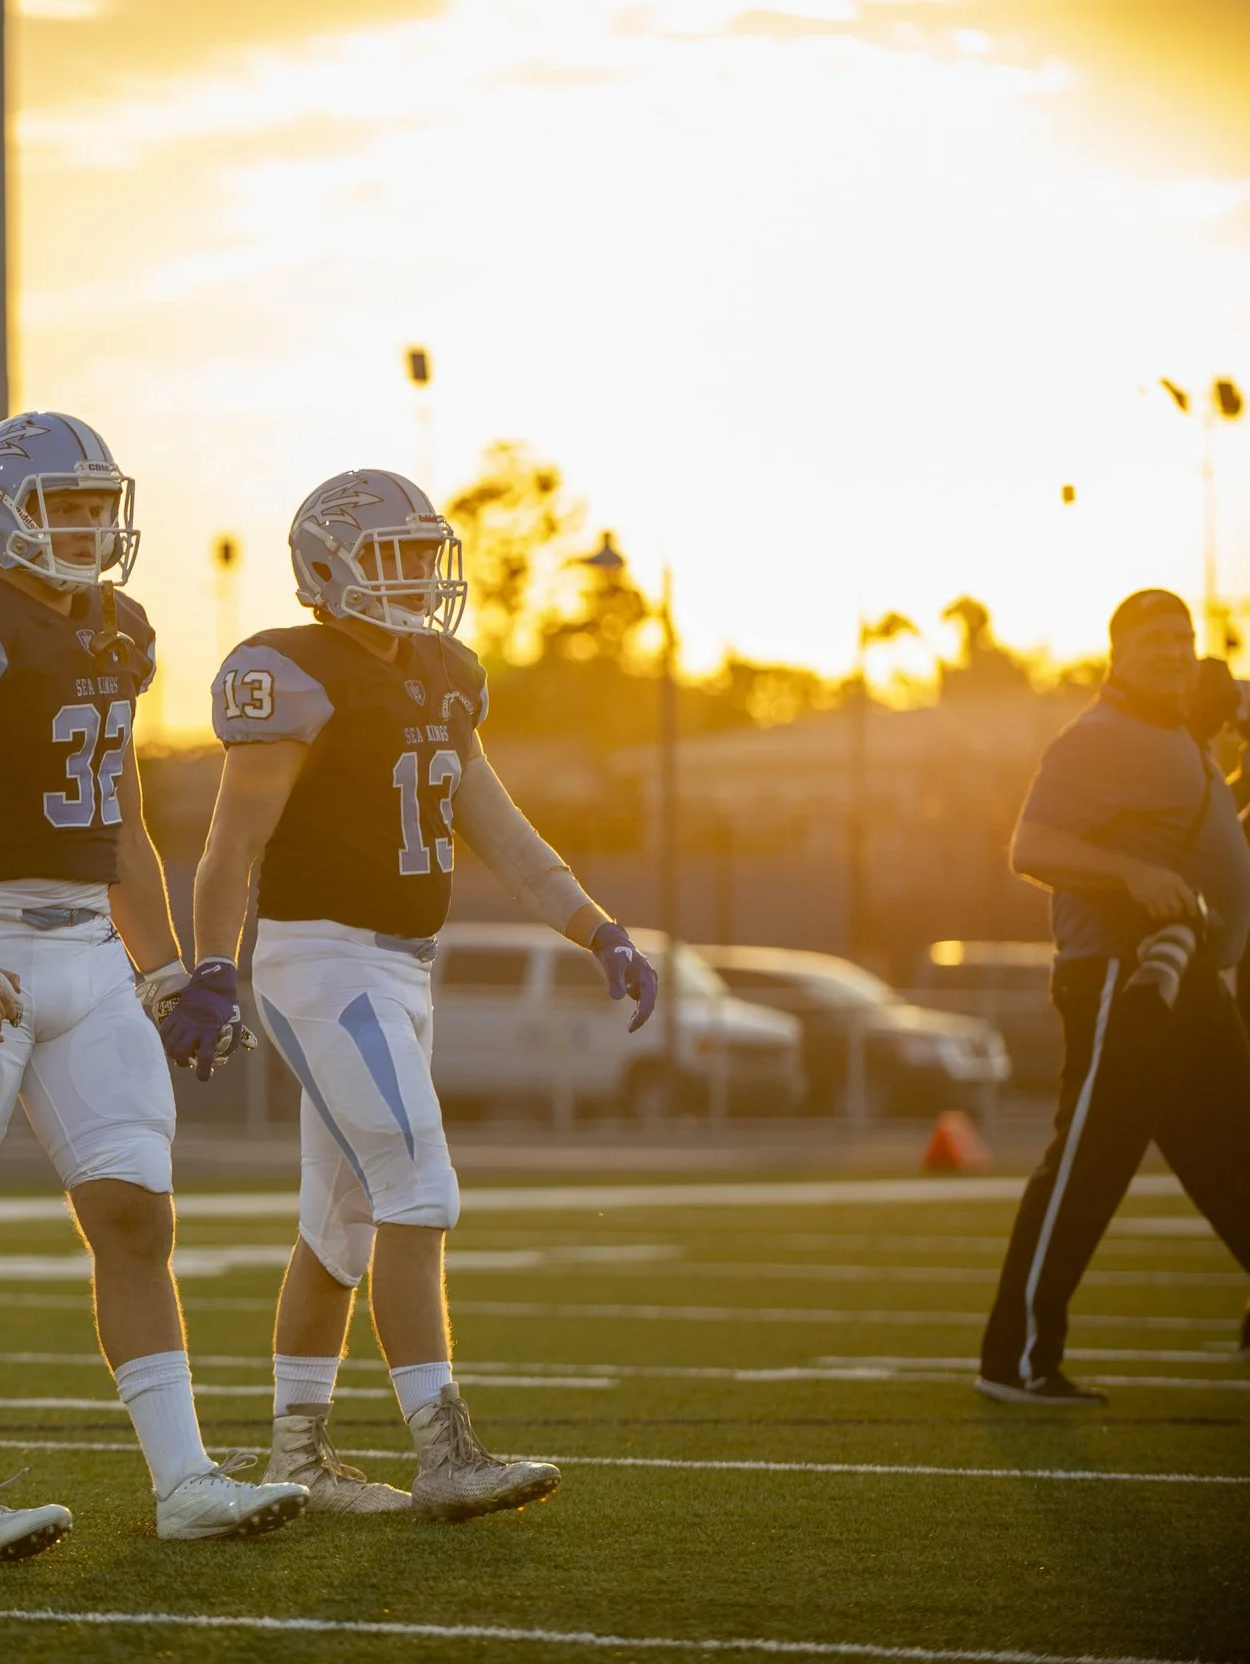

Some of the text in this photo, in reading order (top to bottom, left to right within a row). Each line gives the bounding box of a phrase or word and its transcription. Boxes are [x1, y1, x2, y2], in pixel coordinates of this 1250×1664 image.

[75, 675, 118, 697] SEA KINGS
[224, 669, 275, 721] 13
[404, 724, 449, 744] SEA KINGS
[43, 699, 132, 828] 32
[392, 749, 462, 875] 13
